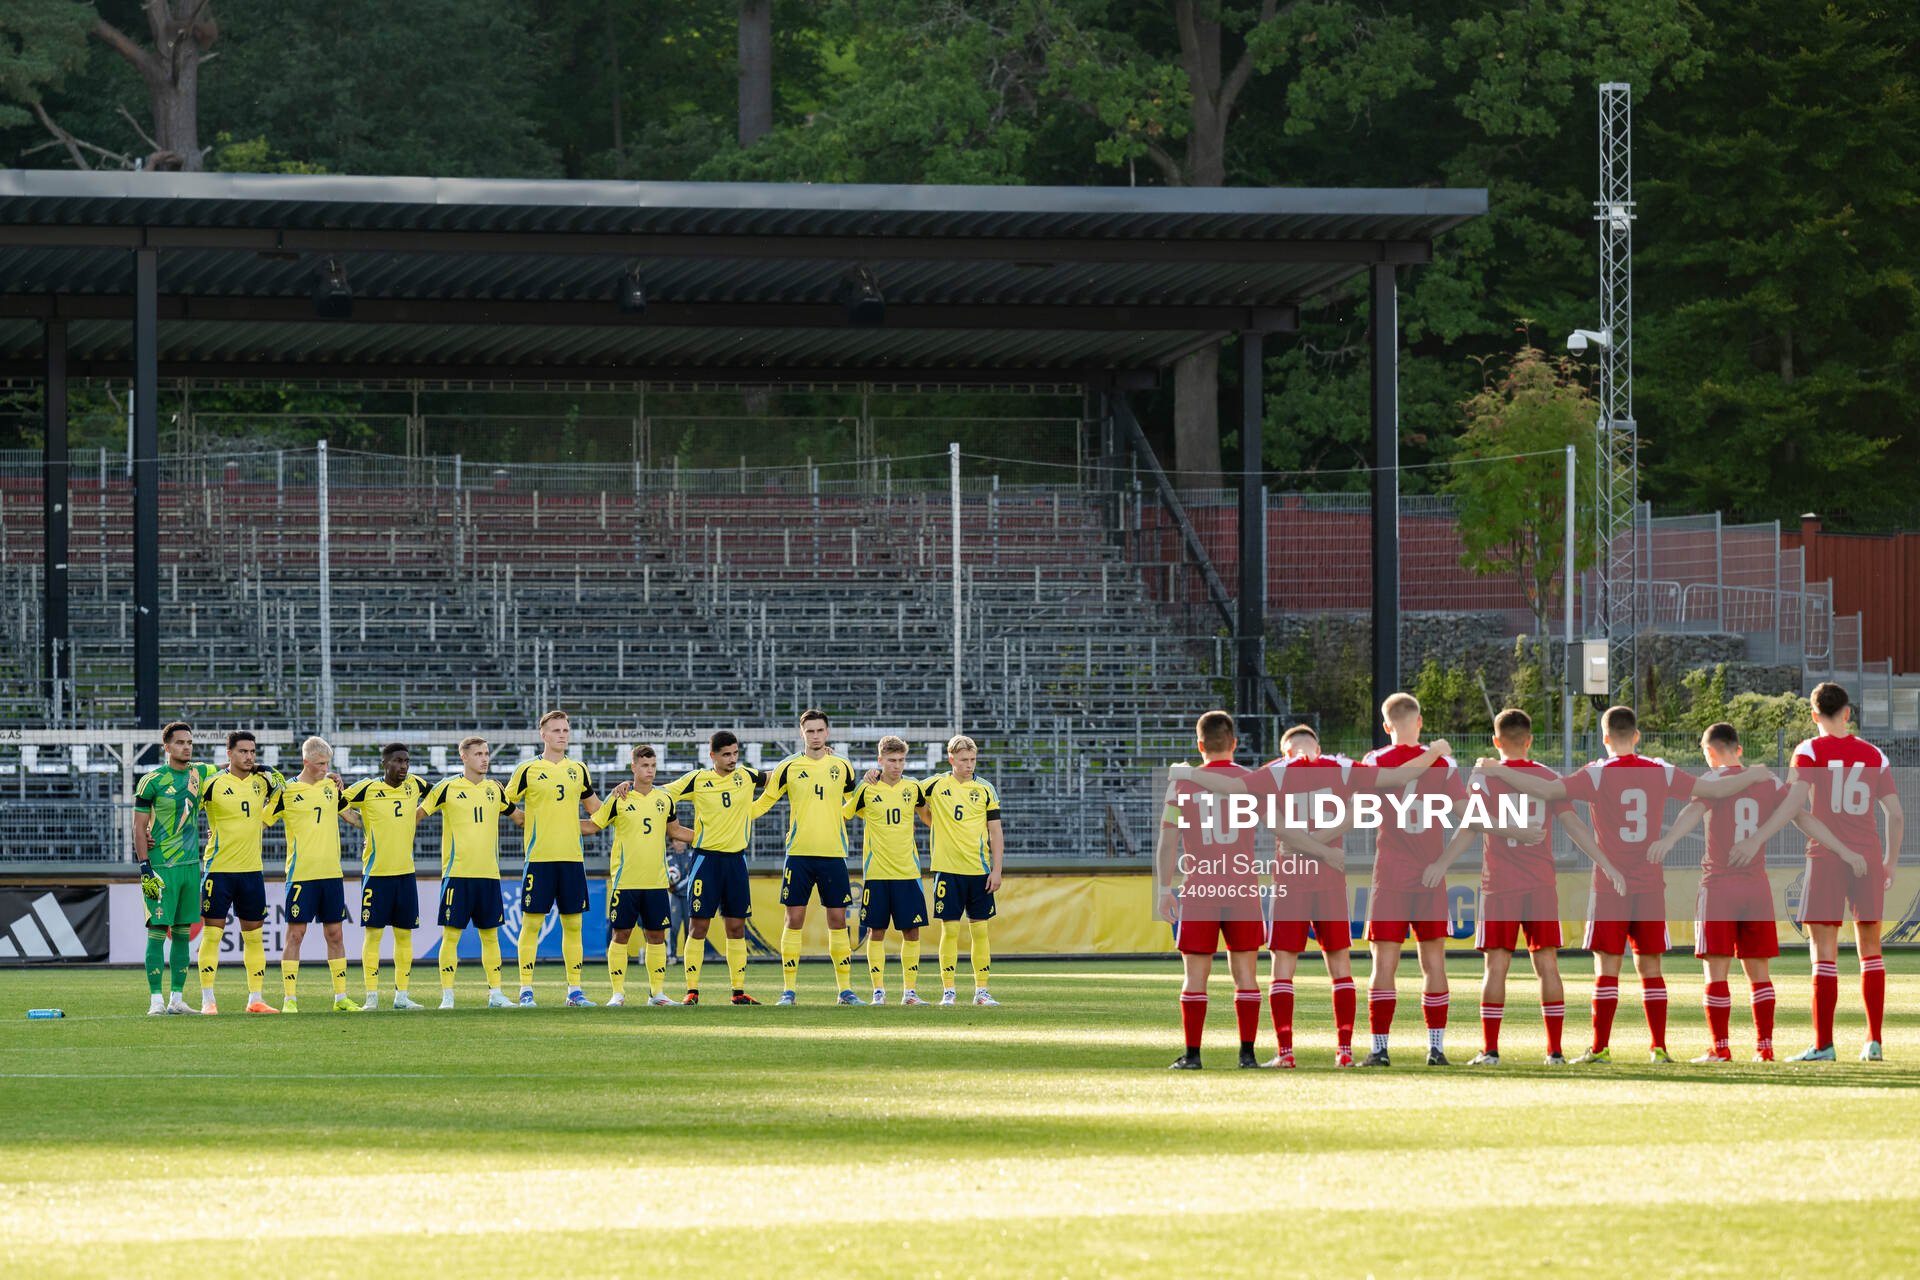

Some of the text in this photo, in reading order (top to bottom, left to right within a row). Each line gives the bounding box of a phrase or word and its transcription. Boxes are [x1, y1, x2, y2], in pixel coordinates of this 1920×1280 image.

[8, 729, 22, 739] AS
[683, 728, 696, 737] AS
[556, 784, 565, 801] 3
[815, 784, 823, 800] 4
[1827, 759, 1871, 816] 16
[393, 800, 403, 817] 2
[721, 792, 731, 808] 8
[241, 801, 250, 818] 9
[313, 807, 322, 824] 7
[473, 806, 483, 823] 11
[886, 808, 901, 825] 10
[954, 805, 964, 821] 6
[1619, 788, 1648, 843] 3
[643, 817, 652, 835] 5
[1734, 797, 1760, 845] 8
[525, 874, 534, 891] 3
[784, 867, 792, 885] 4
[205, 879, 214, 897] 9
[293, 884, 302, 902] 7
[693, 879, 703, 897] 8
[937, 880, 947, 898] 6
[363, 888, 373, 906] 2
[446, 888, 455, 906] 11
[611, 890, 621, 907] 5
